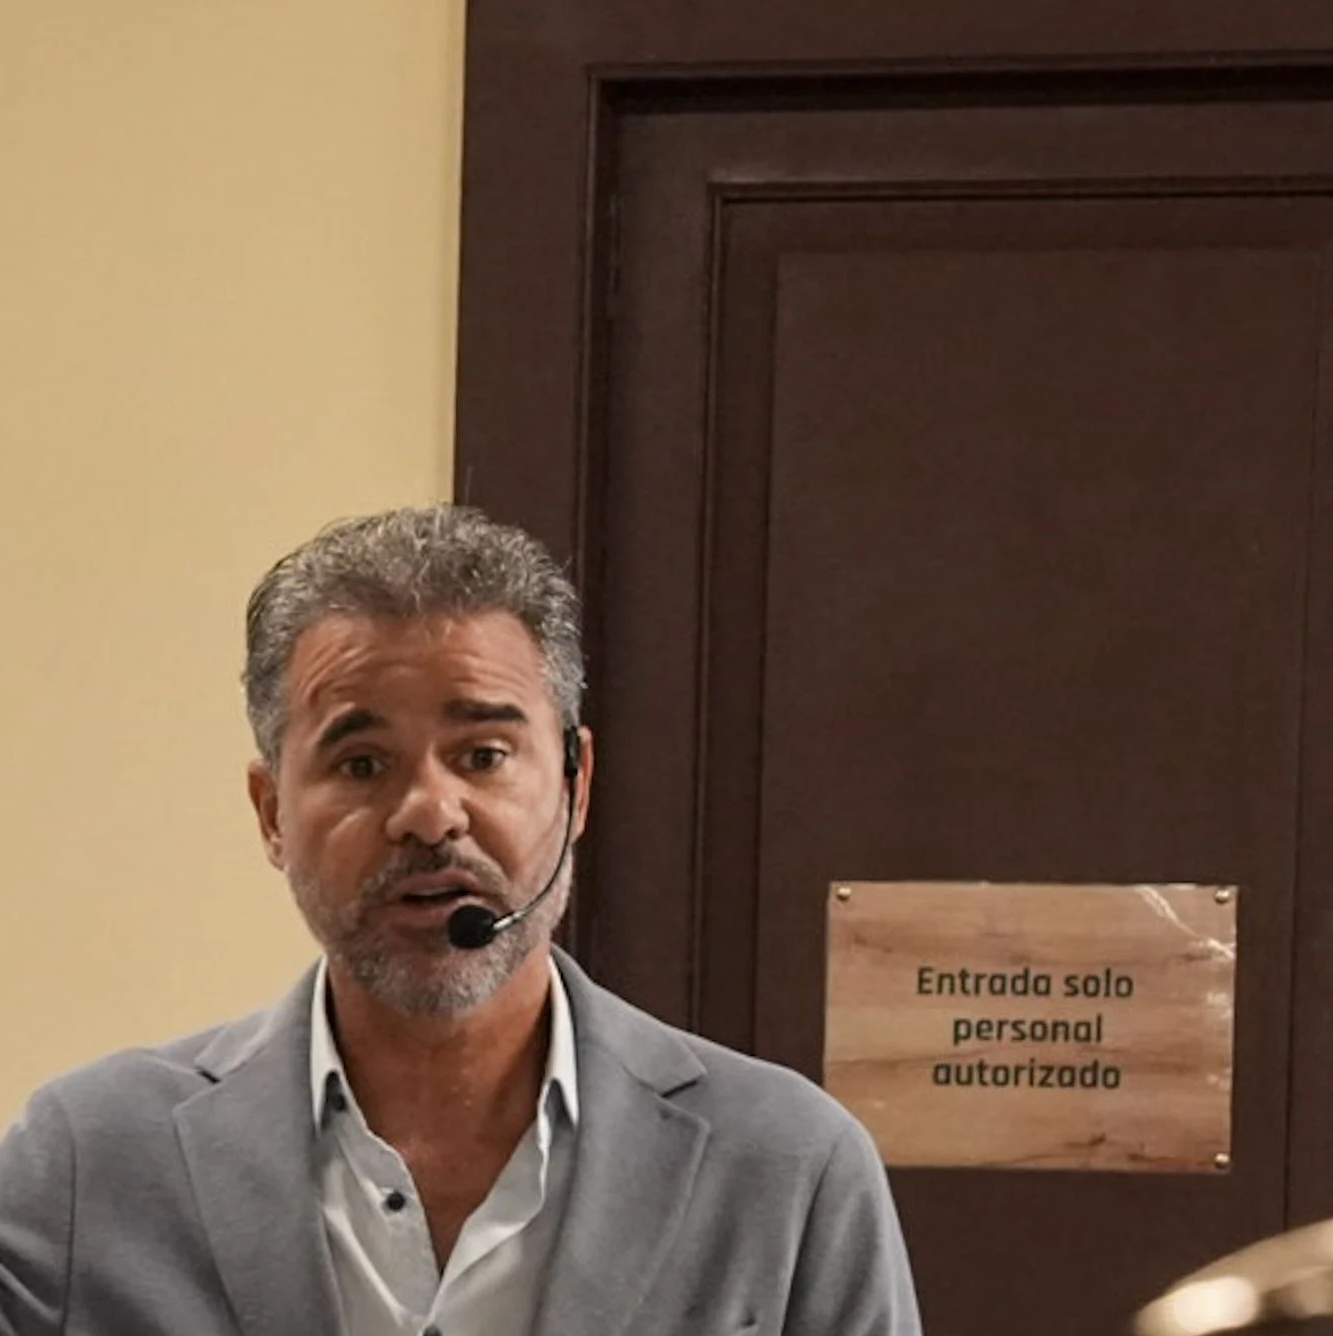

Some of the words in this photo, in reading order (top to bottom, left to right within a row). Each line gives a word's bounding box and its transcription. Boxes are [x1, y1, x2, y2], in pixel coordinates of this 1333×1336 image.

[916, 966, 1052, 998] Entrada
[1062, 967, 1135, 999] solo
[952, 1013, 1104, 1046] personal
[932, 1057, 1122, 1090] autorizado
